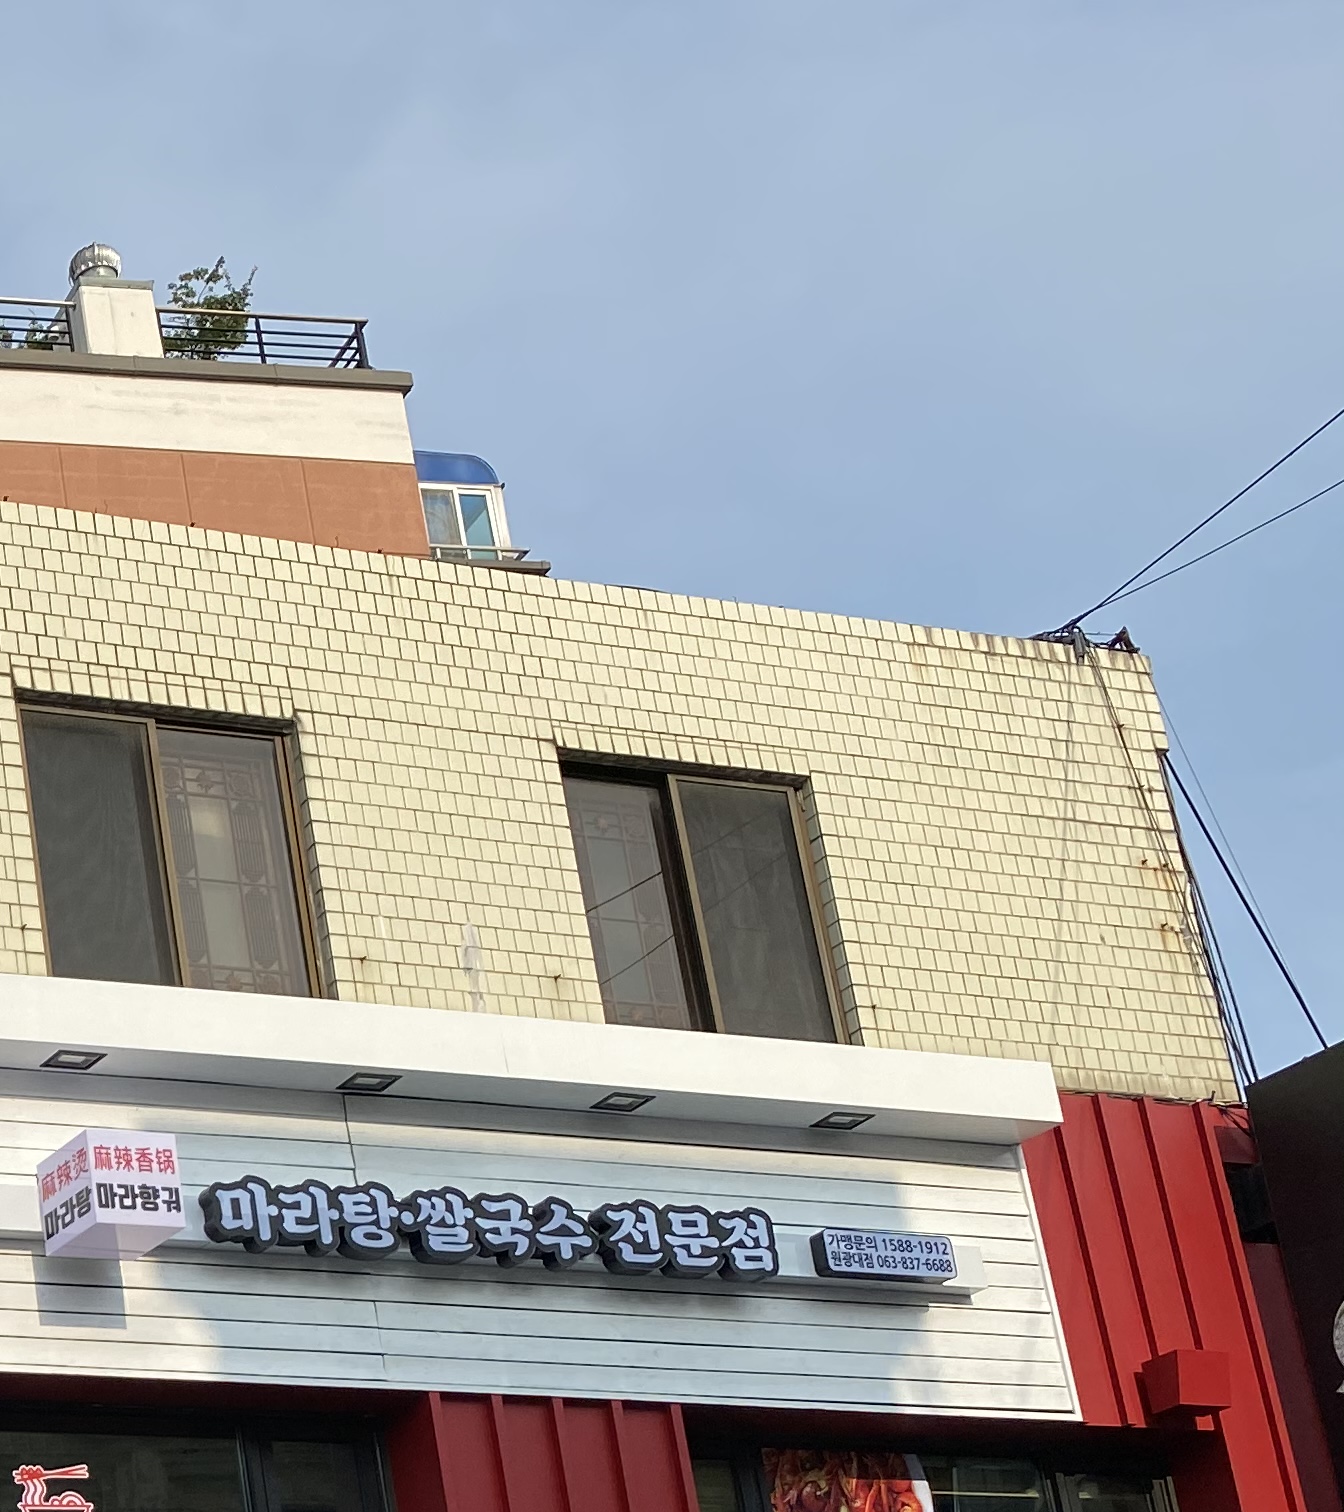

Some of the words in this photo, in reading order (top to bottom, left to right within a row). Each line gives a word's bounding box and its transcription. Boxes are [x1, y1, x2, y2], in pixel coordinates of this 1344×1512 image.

[41, 1147, 89, 1202] 麻辣烫
[93, 1145, 176, 1175] 麻辣香锅
[95, 1182, 182, 1213] 마라향궈
[44, 1186, 93, 1241] 마라탕
[606, 1206, 777, 1274] 전문점
[826, 1233, 879, 1252] 가맹문의
[881, 1238, 950, 1256] 1588-1912
[830, 1250, 875, 1269] 원광대점
[876, 1254, 954, 1273] 063-837-6688
